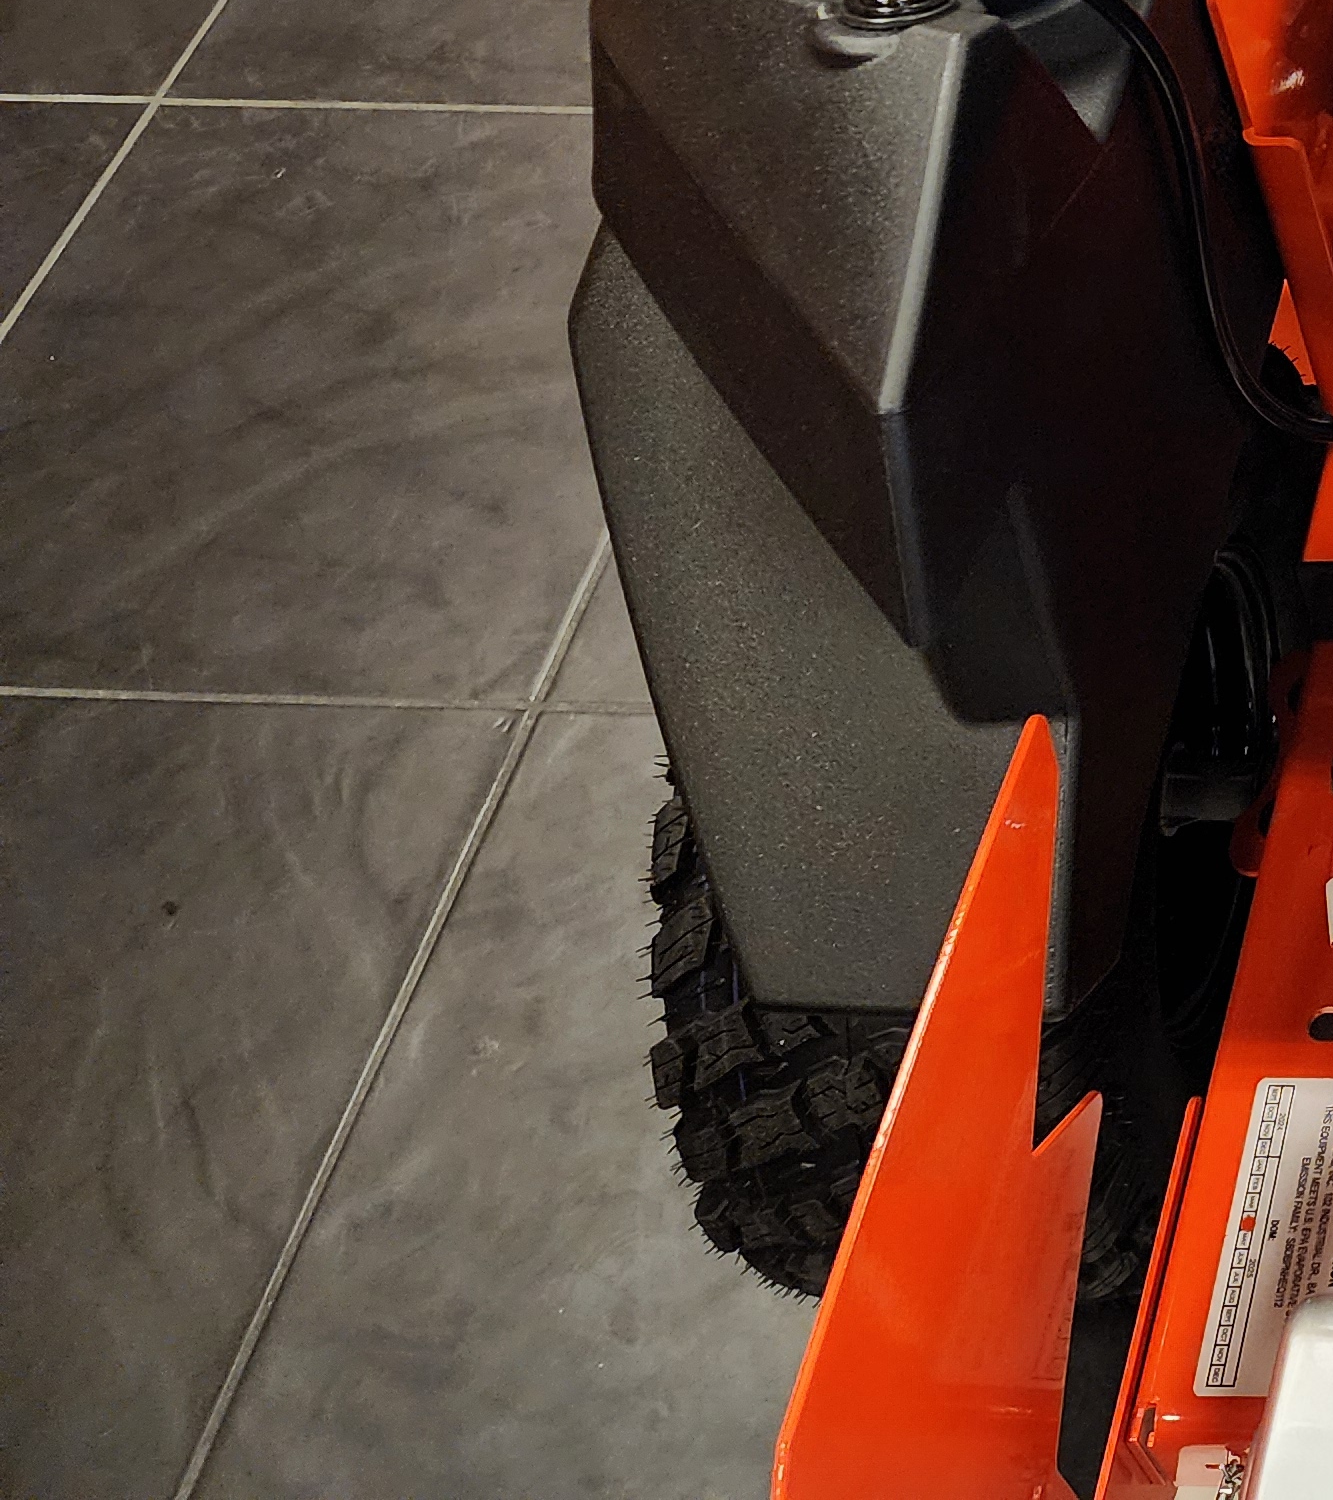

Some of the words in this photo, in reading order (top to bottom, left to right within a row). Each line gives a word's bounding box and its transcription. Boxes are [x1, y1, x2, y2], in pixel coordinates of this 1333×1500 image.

[1267, 1106, 1277, 1119] OCT
[1322, 1105, 1333, 1124] THIS
[1258, 1141, 1268, 1155] DEC
[1312, 1126, 1330, 1176] EQUIPMENT
[1294, 1157, 1311, 1199] EMISSION
[1306, 1177, 1321, 1207] MEETS
[1268, 1219, 1280, 1241] DOM:
[1219, 1328, 1229, 1342] OCT
[1215, 1347, 1225, 1363] NOV
[1211, 1367, 1221, 1384] DEC
